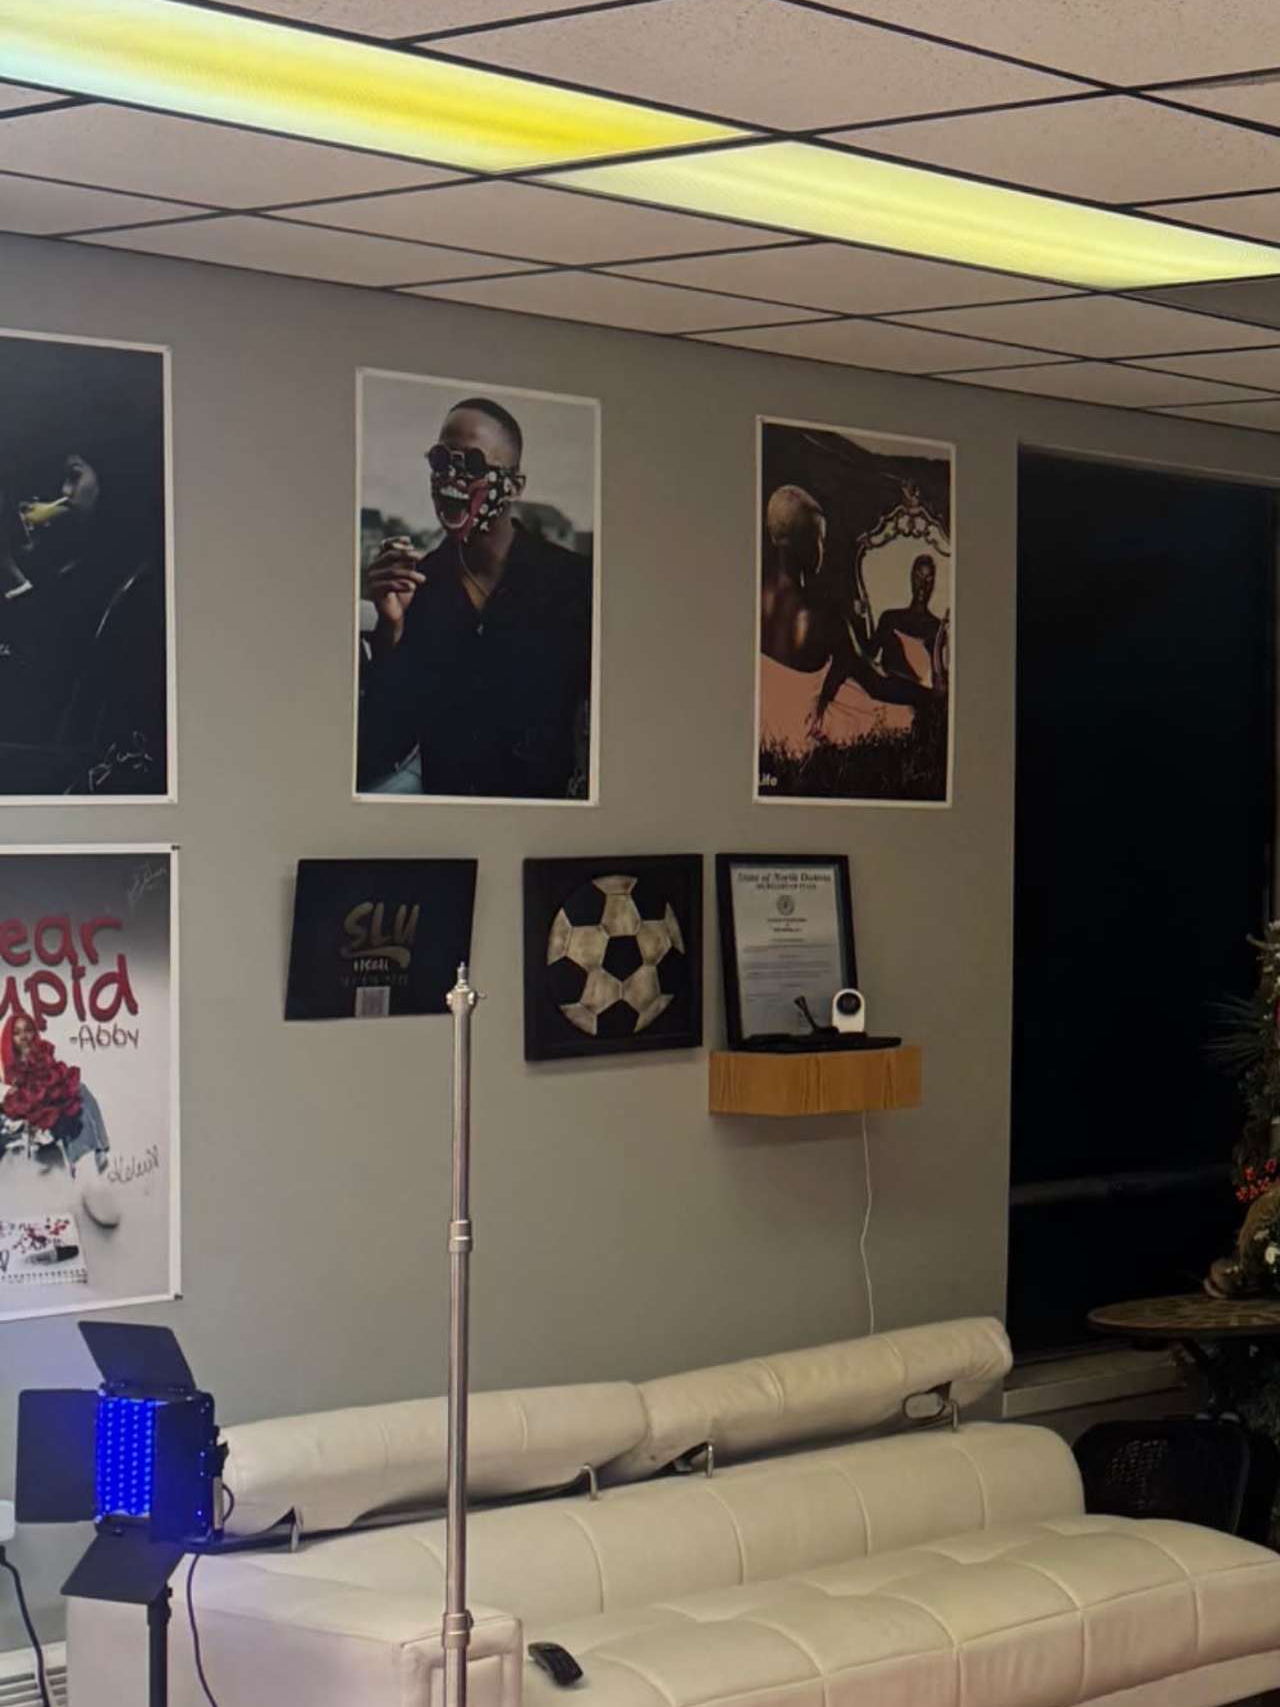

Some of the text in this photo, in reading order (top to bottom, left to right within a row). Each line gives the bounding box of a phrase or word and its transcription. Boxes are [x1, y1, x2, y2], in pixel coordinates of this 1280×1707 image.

[0, 914, 123, 966] ear
[344, 901, 421, 950] SLU
[0, 954, 138, 1032] upid
